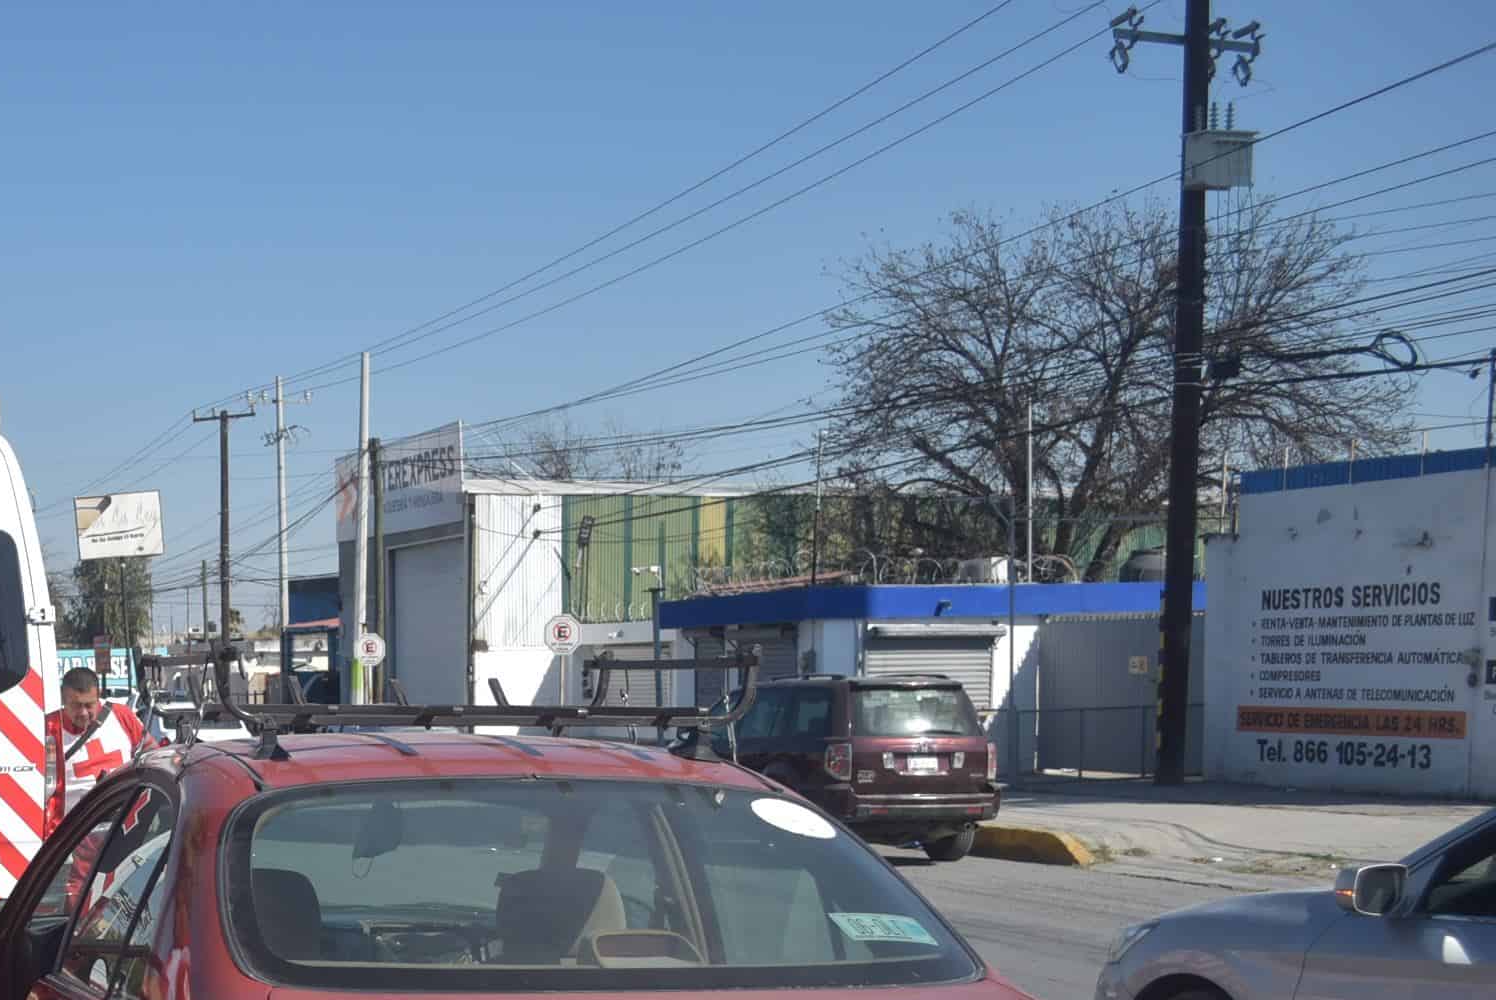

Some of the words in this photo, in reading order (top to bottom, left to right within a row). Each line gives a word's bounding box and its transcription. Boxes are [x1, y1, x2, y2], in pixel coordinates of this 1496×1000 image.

[1261, 587, 1344, 610] NUESTROS
[1352, 582, 1441, 608] SERVICIOS
[1392, 614, 1402, 627] DE
[1404, 613, 1443, 627] PLANTAS
[1445, 613, 1456, 626] DE
[1458, 612, 1476, 626] LUZ
[1261, 635, 1289, 647] TORRES
[1294, 635, 1304, 647] DE
[1260, 652, 1302, 664] TABLEROS
[1306, 652, 1316, 664] DE
[1321, 652, 1393, 664] TRANSFERENCIA
[1259, 670, 1321, 682] COMPRESORES
[1258, 687, 1294, 699] SERVICIO
[1295, 688, 1301, 699] A
[1305, 688, 1344, 700] ANTENAS
[1347, 688, 1357, 700] DE
[1362, 685, 1455, 702] TELECOMUNICACIÓN
[1288, 713, 1299, 728] DE
[1404, 716, 1422, 732] 24
[1256, 739, 1287, 763] Tel.
[1294, 740, 1328, 764] 866
[1336, 742, 1432, 770] 105-24-13
